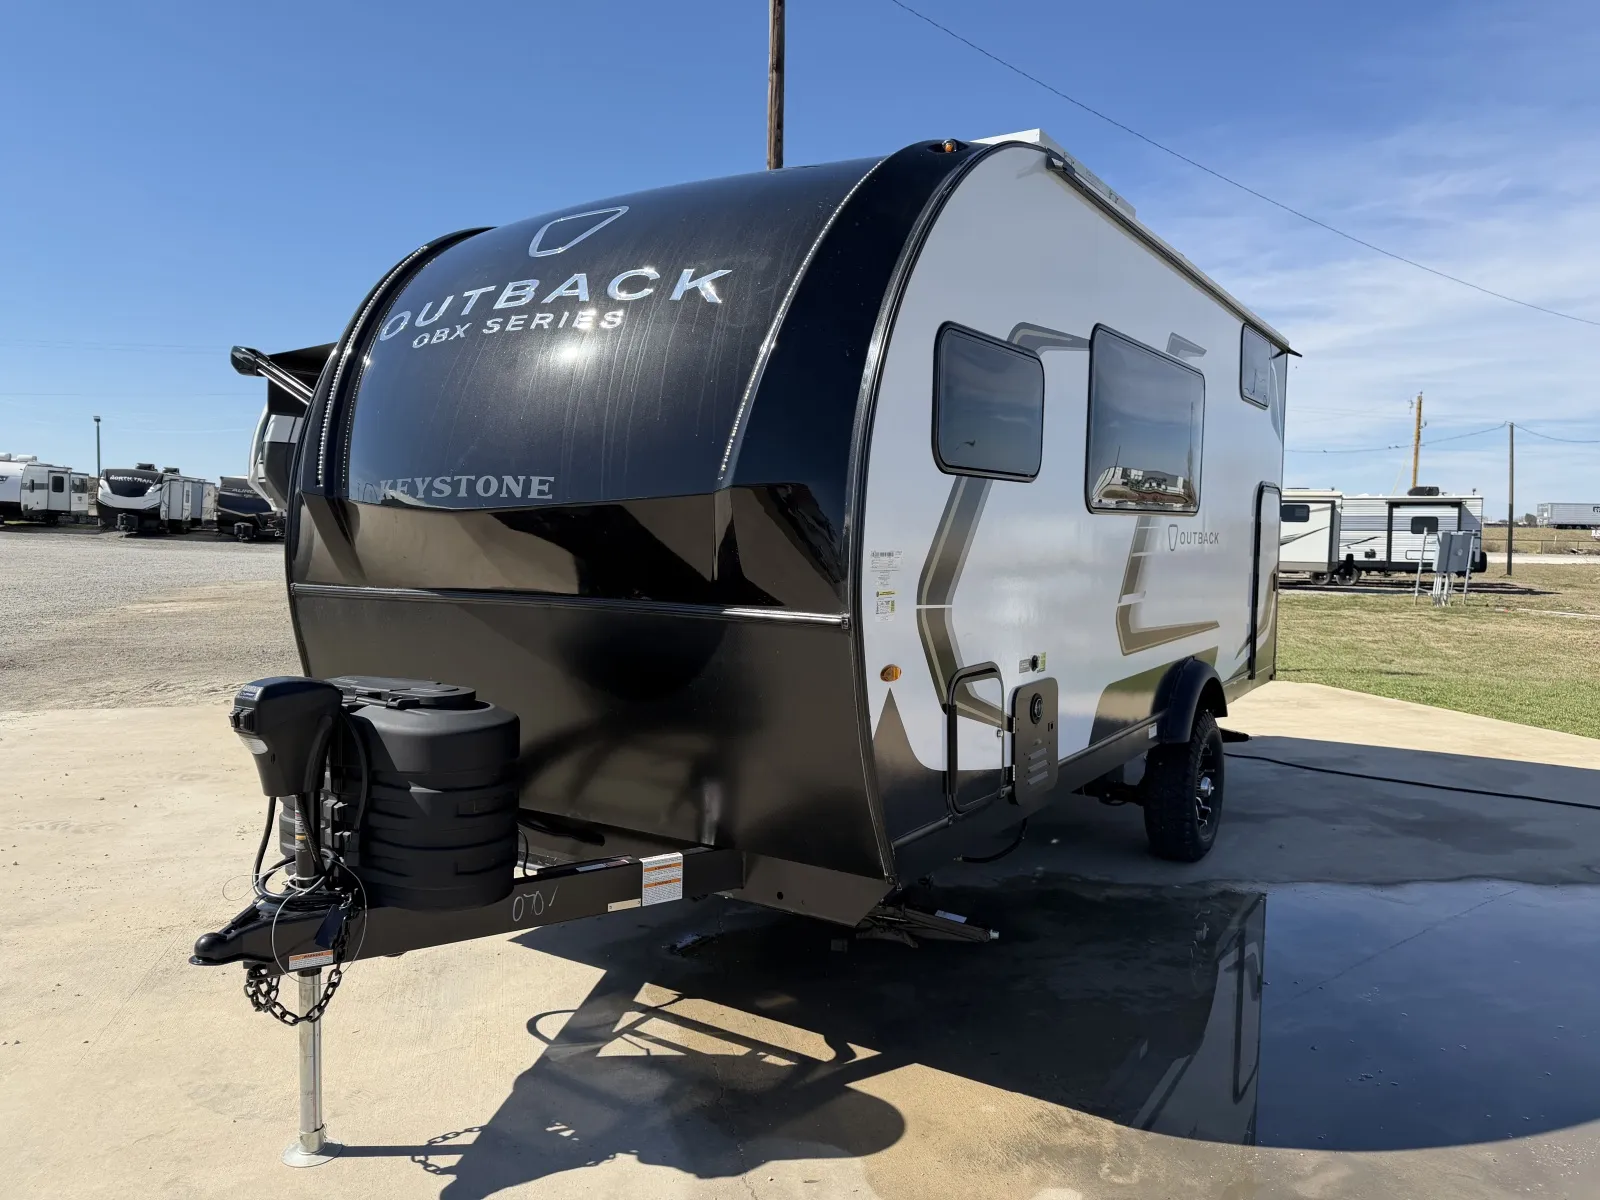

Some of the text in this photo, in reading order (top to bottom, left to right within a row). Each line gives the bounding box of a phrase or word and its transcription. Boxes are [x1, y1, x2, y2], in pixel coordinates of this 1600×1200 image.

[379, 267, 733, 342] OUTBACK
[411, 309, 624, 349] OBX SERIES
[379, 475, 555, 501] KEYSTONE
[1180, 531, 1219, 545] OUTBACK
